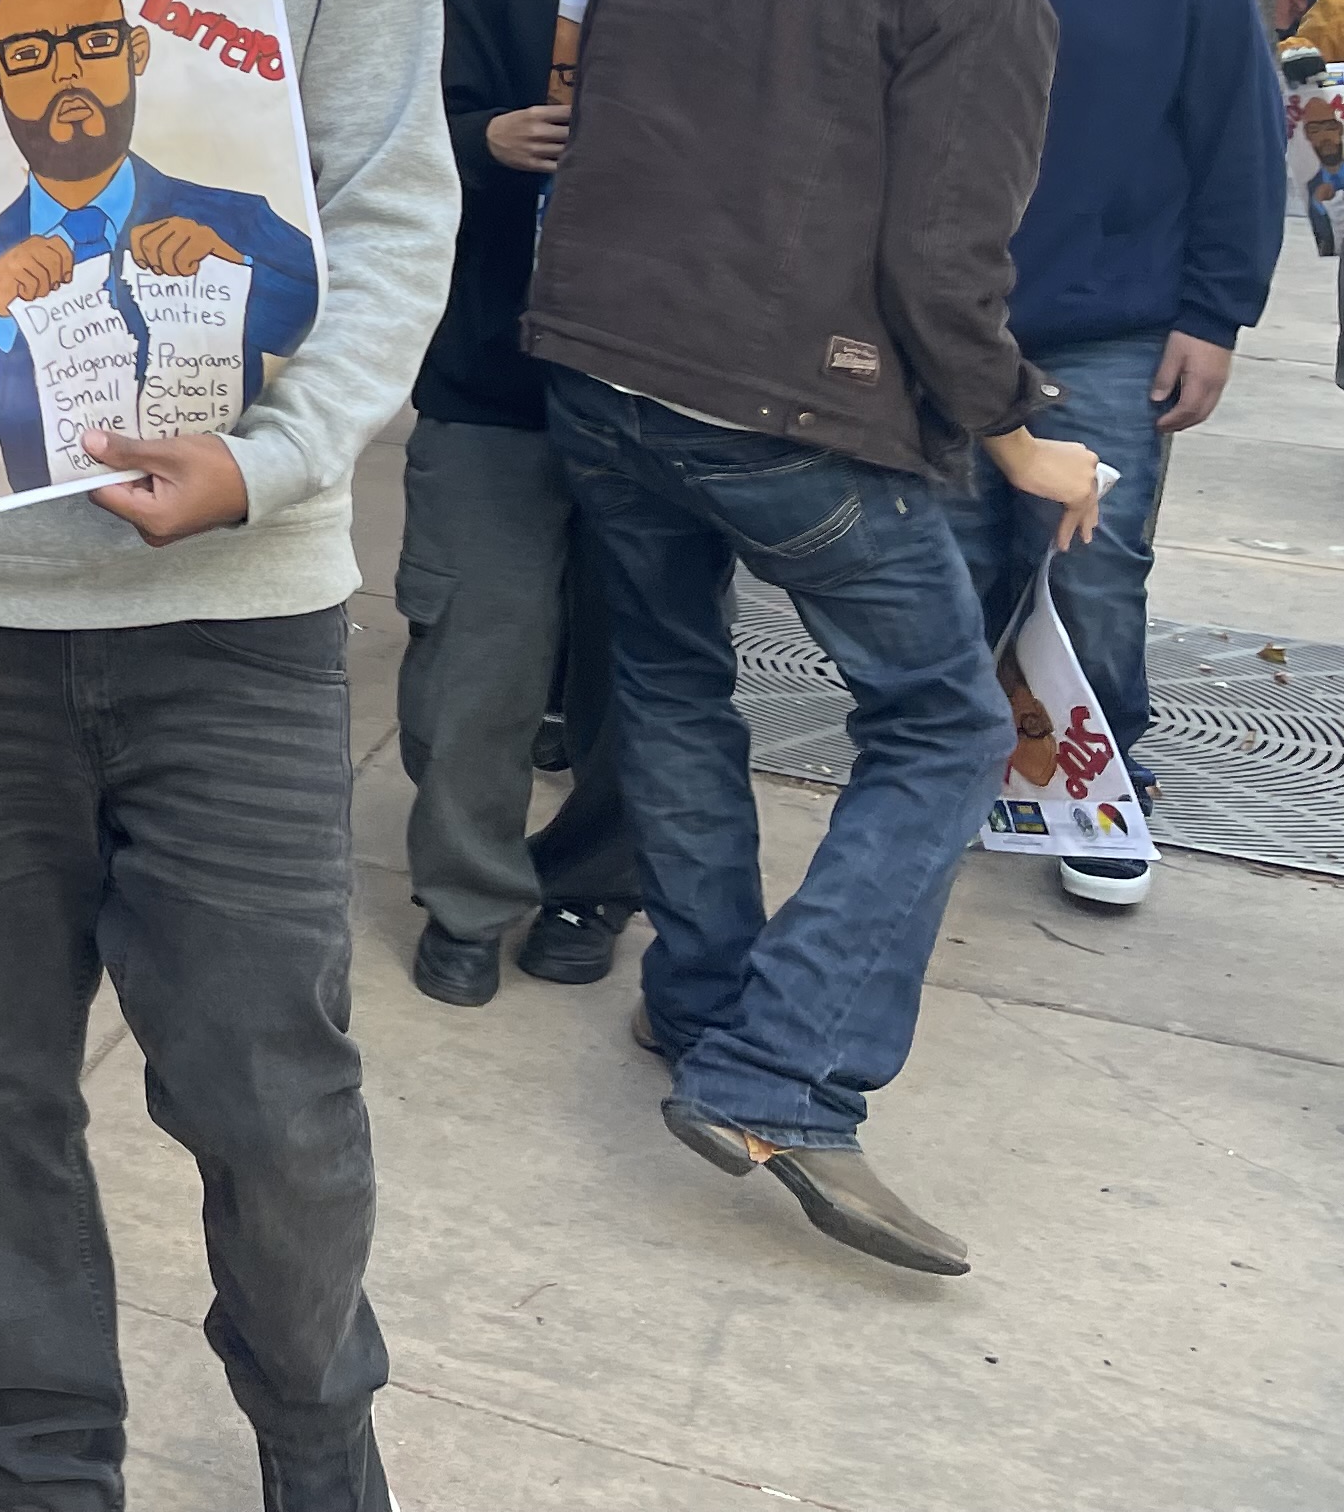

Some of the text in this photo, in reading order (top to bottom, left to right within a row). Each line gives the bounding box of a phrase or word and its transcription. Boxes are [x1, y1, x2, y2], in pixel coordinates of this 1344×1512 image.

[25, 273, 231, 335] Denver Families
[58, 304, 227, 350] Comm unities
[42, 343, 242, 388] Indigenous Programs
[54, 375, 228, 411] Small Schools
[57, 414, 127, 443] Online
[147, 402, 230, 426] Schools
[1055, 705, 1114, 800] STOP
